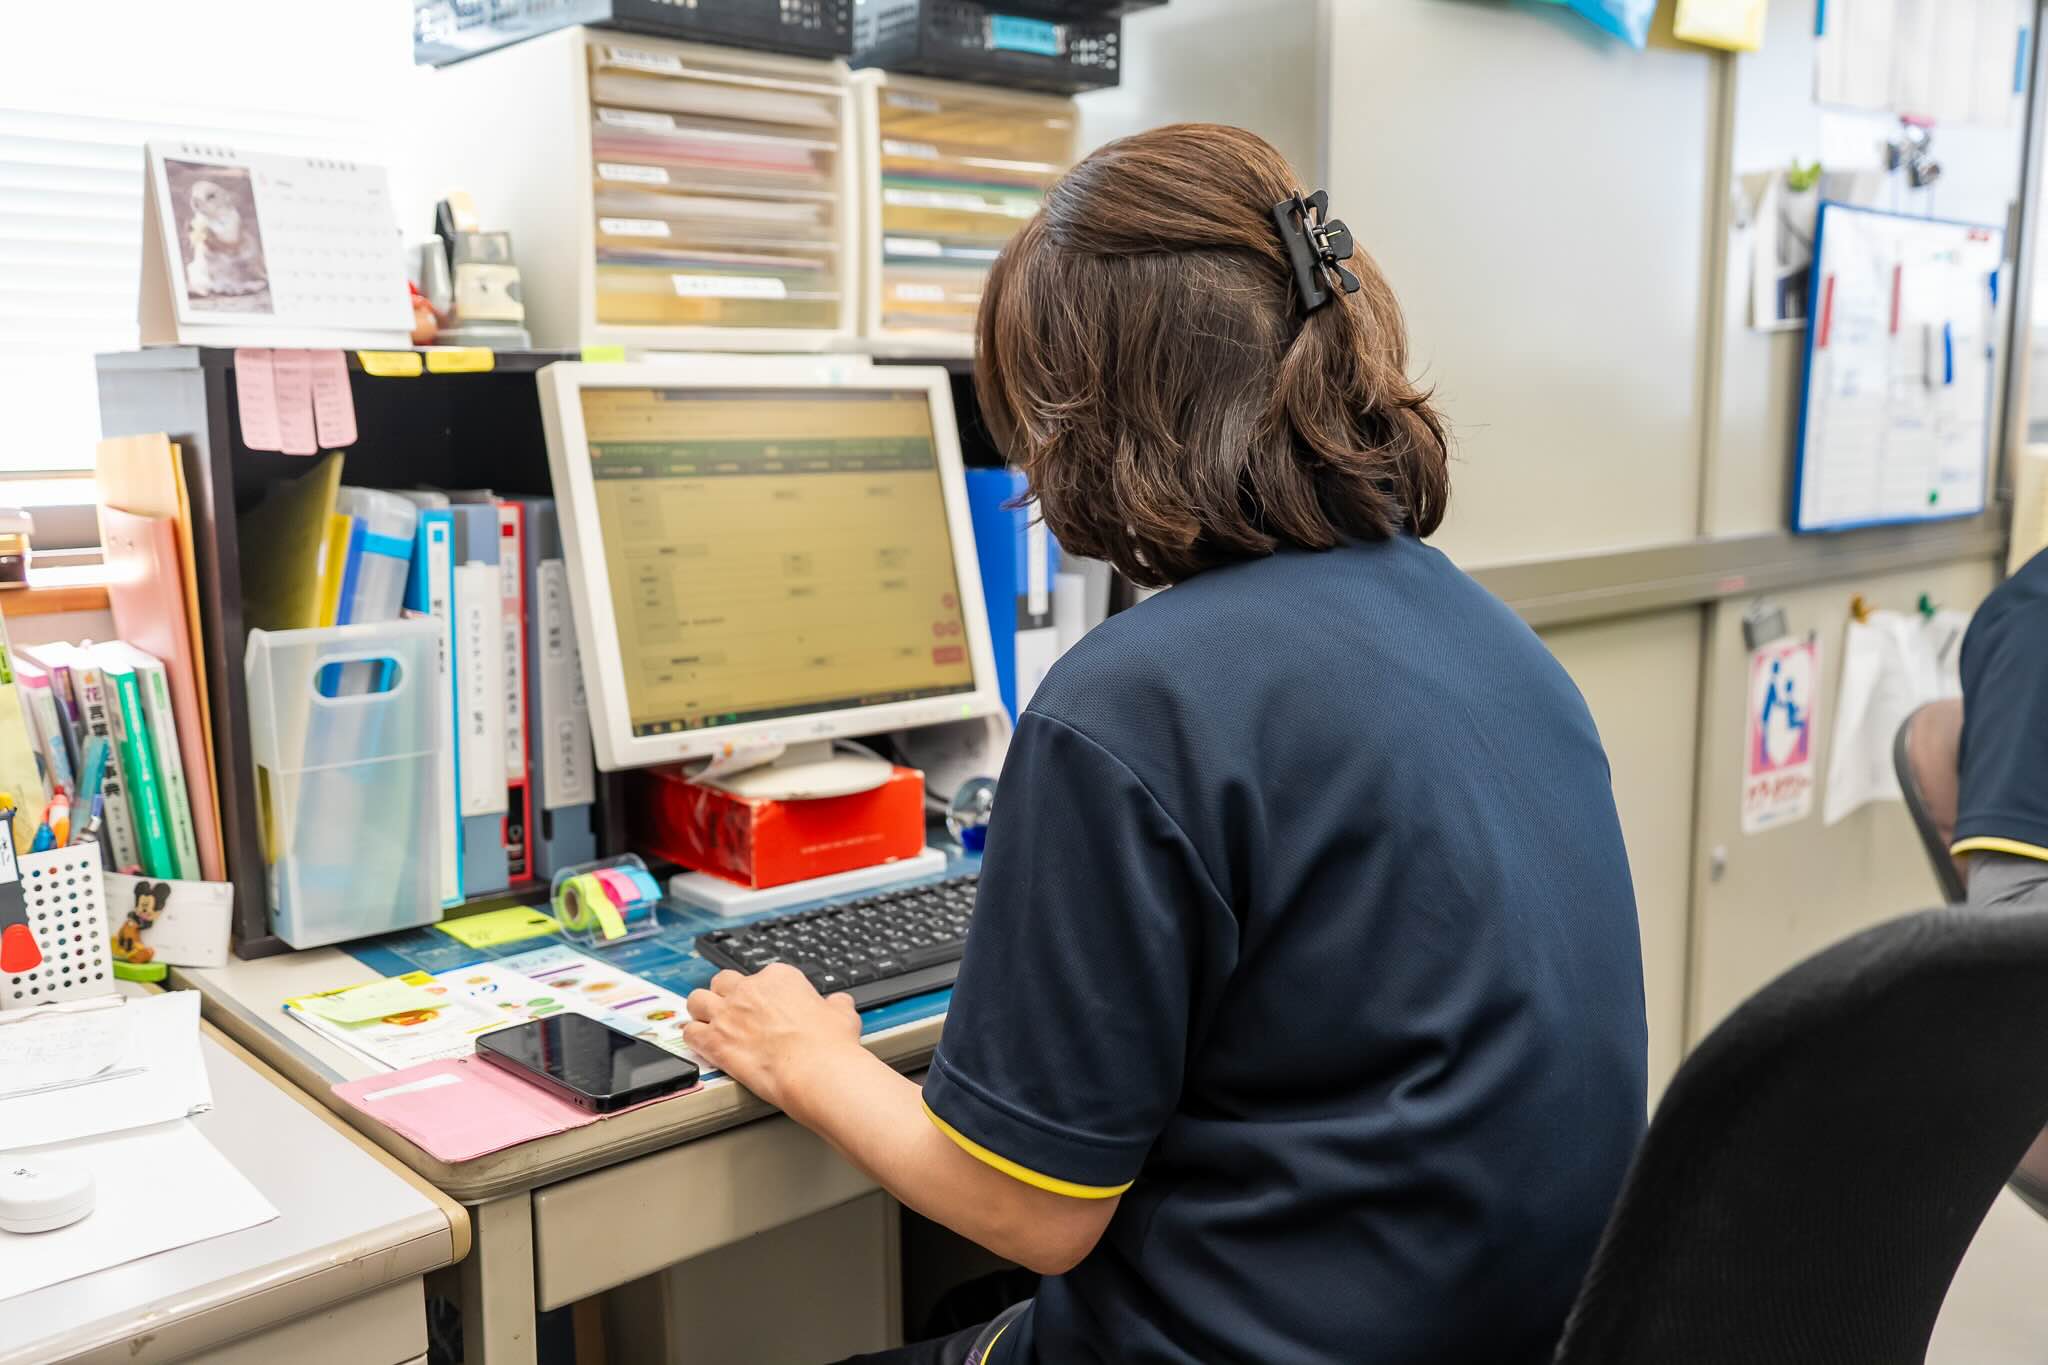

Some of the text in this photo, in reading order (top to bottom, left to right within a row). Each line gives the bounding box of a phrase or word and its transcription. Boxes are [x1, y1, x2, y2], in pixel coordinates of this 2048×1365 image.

[85, 687, 120, 796] 花言葉事典
